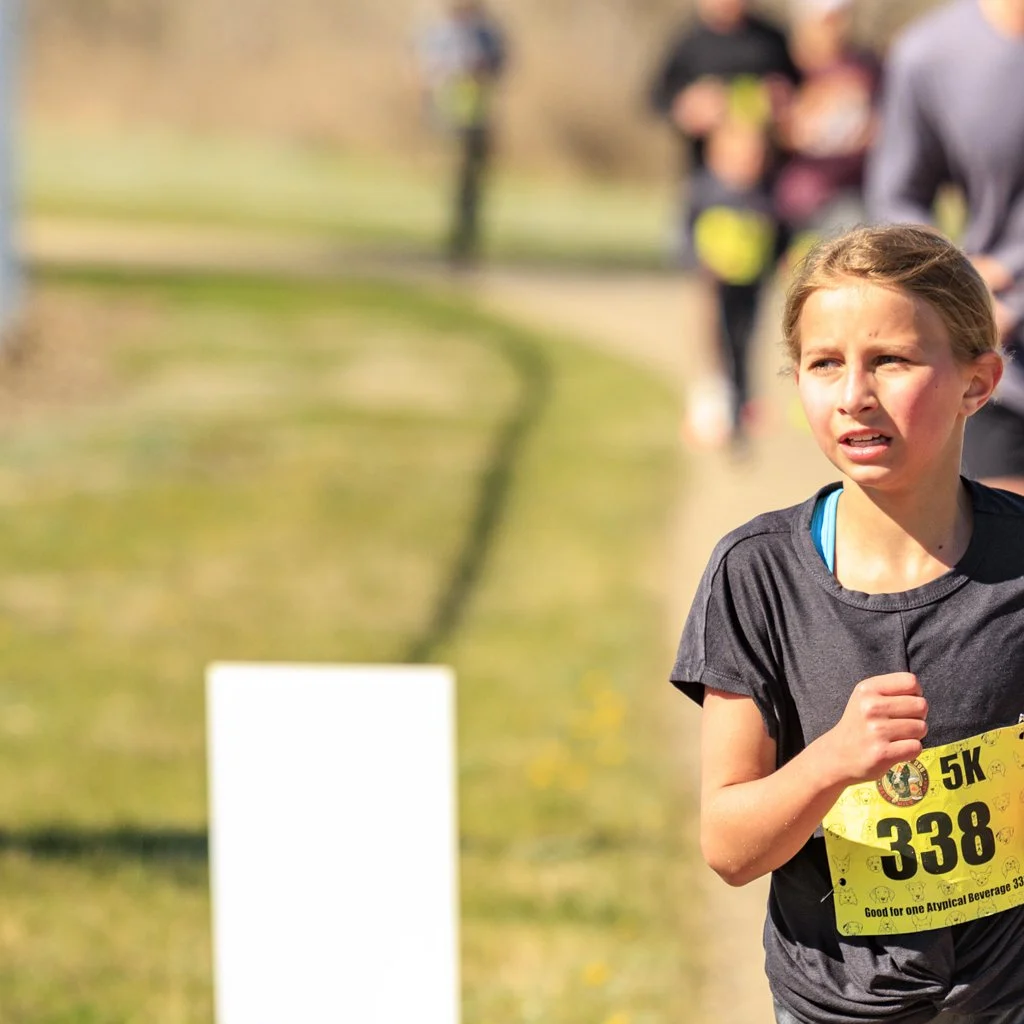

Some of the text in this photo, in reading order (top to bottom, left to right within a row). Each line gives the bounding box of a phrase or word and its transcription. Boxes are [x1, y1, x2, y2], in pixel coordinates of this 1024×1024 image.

[940, 746, 987, 790] 5K
[876, 801, 996, 881] 338
[864, 907, 888, 918] Good
[890, 906, 903, 917] for
[905, 905, 925, 916] one
[926, 895, 967, 914] Atypical
[968, 883, 1011, 903] Beverage
